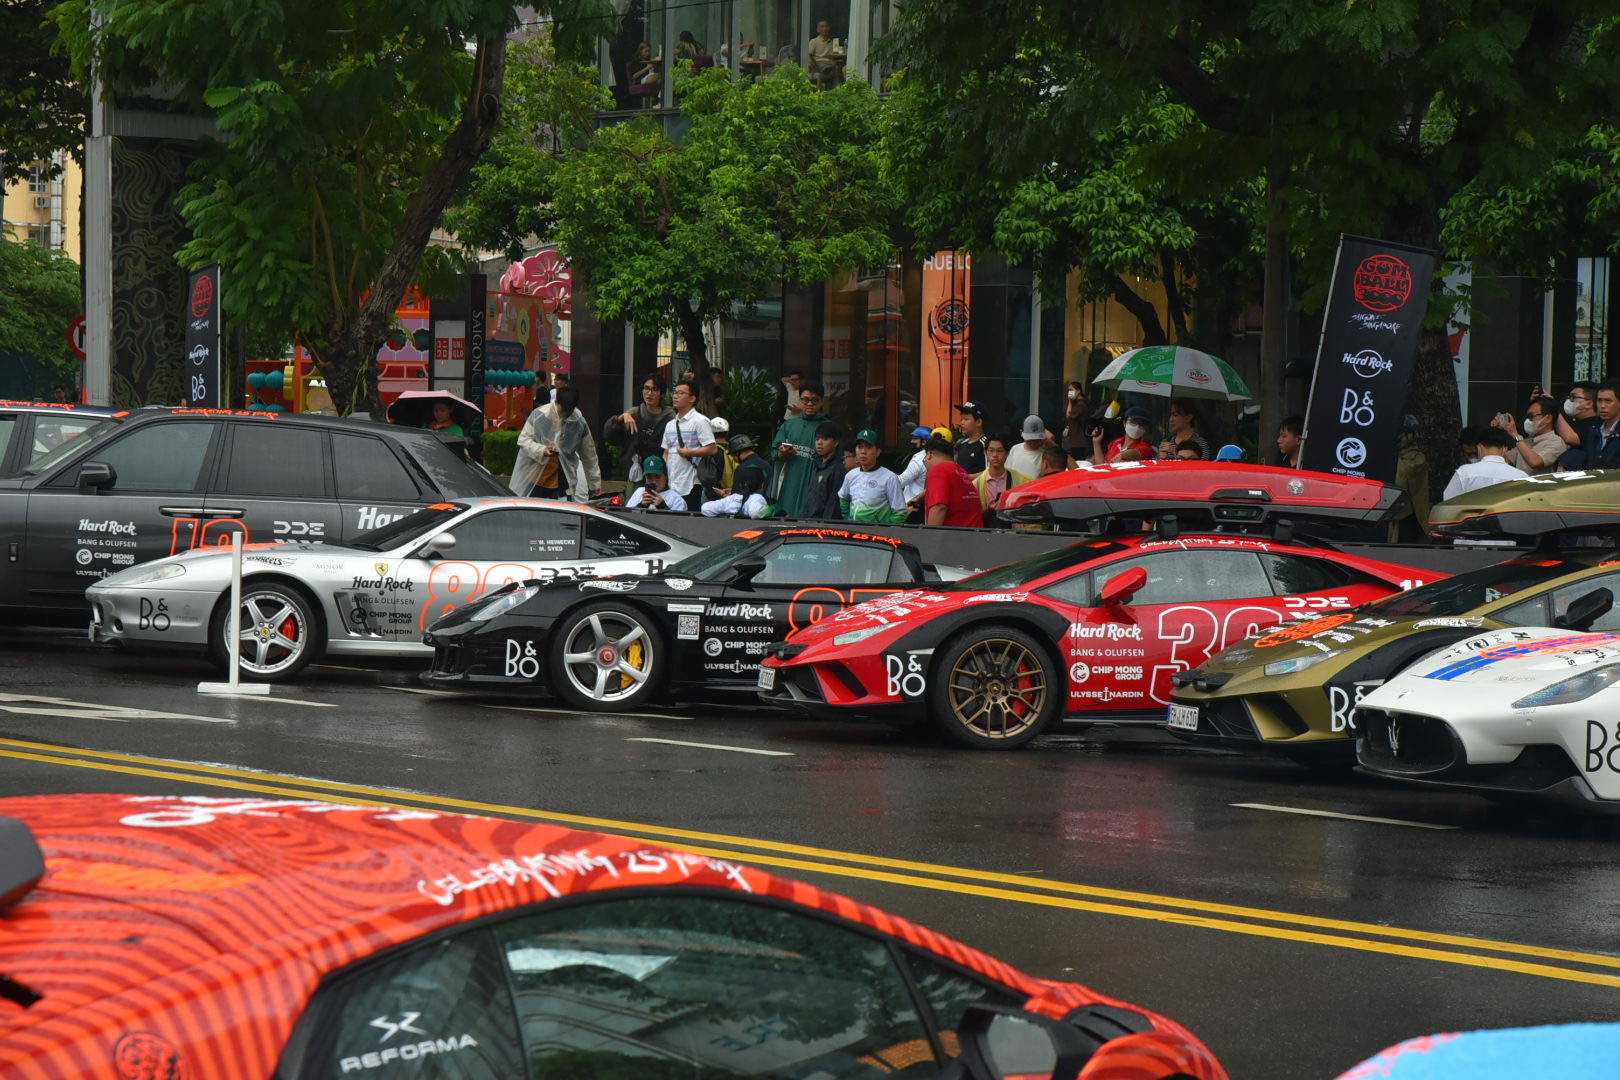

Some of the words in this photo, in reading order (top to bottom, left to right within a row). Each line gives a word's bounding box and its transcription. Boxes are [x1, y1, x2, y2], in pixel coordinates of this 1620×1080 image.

[471, 310, 484, 371] SAIGON
[1342, 352, 1368, 366] Hard
[1368, 357, 1393, 371] Rock
[191, 374, 206, 401] B&O
[1339, 388, 1374, 426] B&O
[78, 519, 109, 532] Hard
[108, 520, 137, 535] Rock
[273, 520, 325, 535] DDE
[77, 538, 98, 546] BANG
[104, 540, 137, 548] OLUFSEN
[352, 576, 383, 589] Hard
[384, 577, 414, 592] Rock
[1282, 597, 1351, 608] DDE
[138, 597, 171, 632] B&O
[705, 603, 739, 617] Hard
[740, 605, 774, 620] Rock
[704, 625, 729, 633] BANG
[729, 625, 735, 633] &
[736, 625, 774, 634] OLUFSEN
[1070, 623, 1105, 638] Hard
[1107, 624, 1144, 642] Rock
[724, 641, 745, 649] CHIP
[1070, 648, 1095, 656] BANG
[1104, 648, 1145, 657] OLUFSEN
[505, 638, 540, 678] B&O
[704, 663, 734, 671] ULYSSE
[886, 653, 926, 697] B&O
[1091, 666, 1114, 674] CHIP
[1115, 666, 1144, 674] MONG
[1115, 673, 1144, 681] GROUP
[339, 1033, 480, 1074] REFORMA
